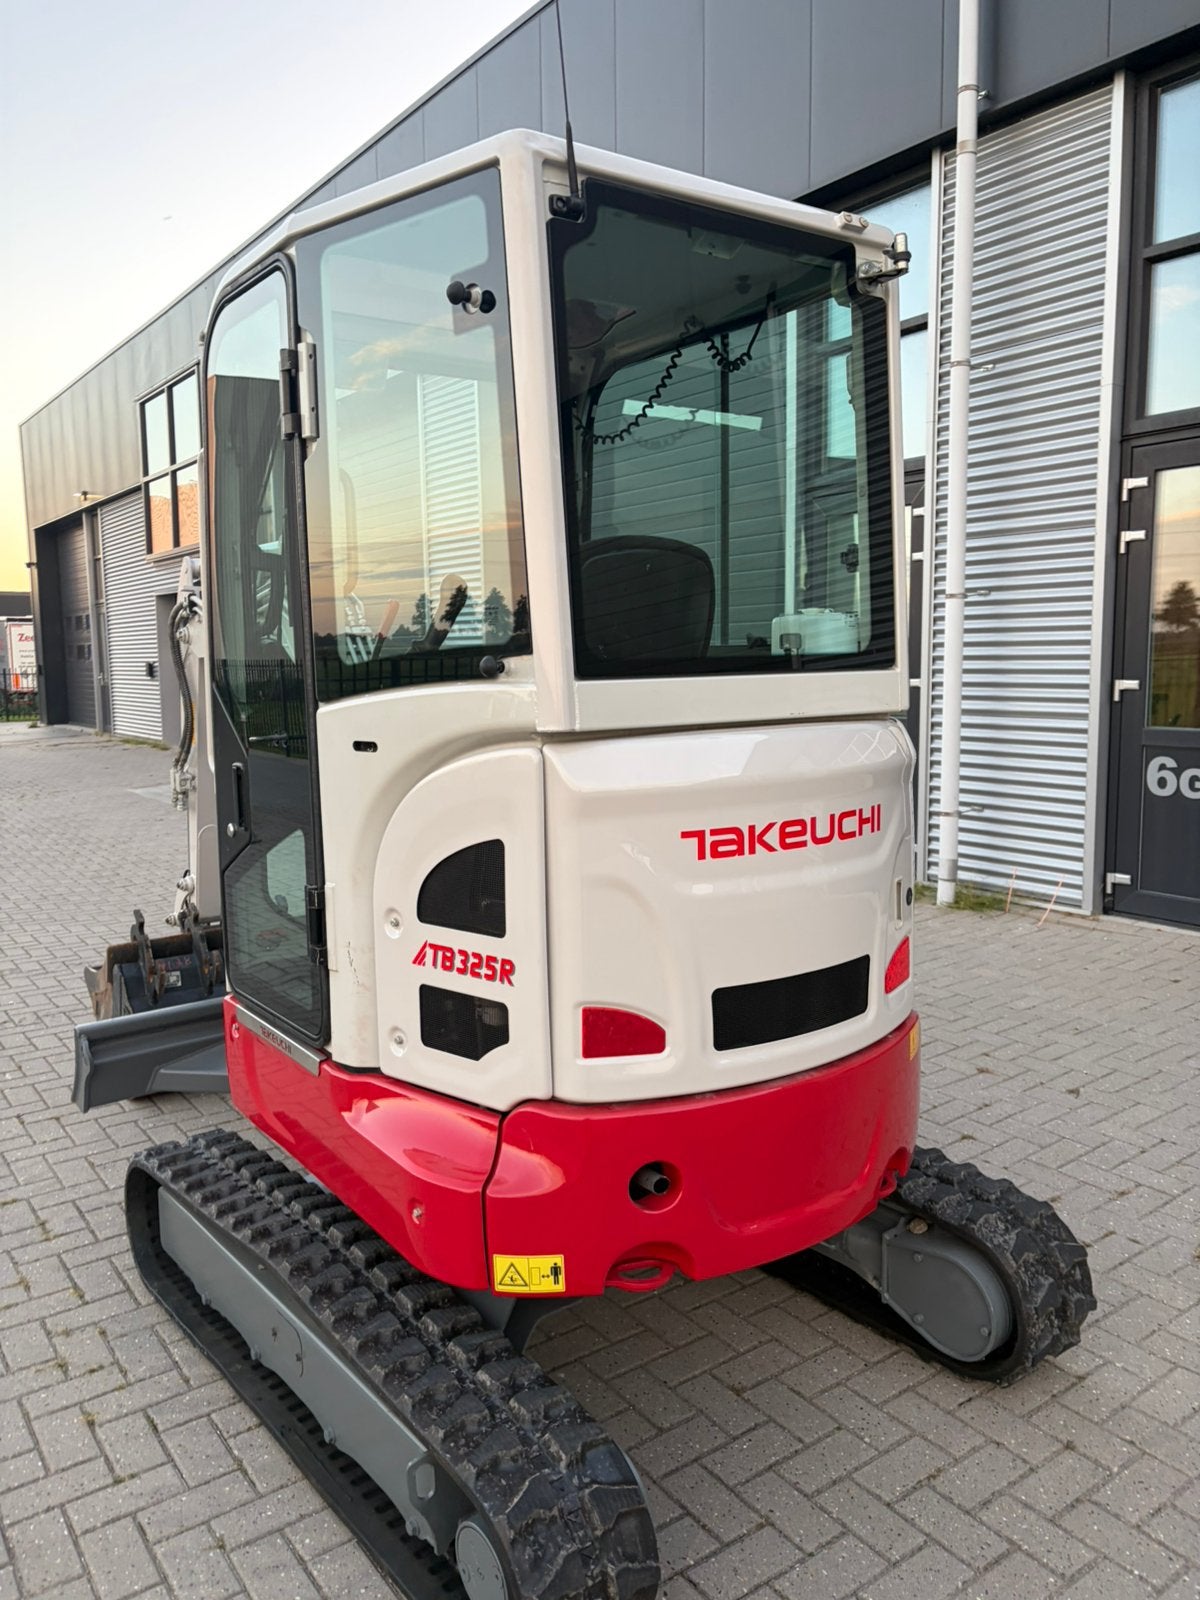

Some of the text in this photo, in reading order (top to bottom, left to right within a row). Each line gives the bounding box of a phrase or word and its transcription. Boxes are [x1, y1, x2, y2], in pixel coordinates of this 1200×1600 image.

[1146, 756, 1200, 799] 6G
[681, 804, 881, 860] TAKEUCHI
[428, 942, 515, 987] TB325R
